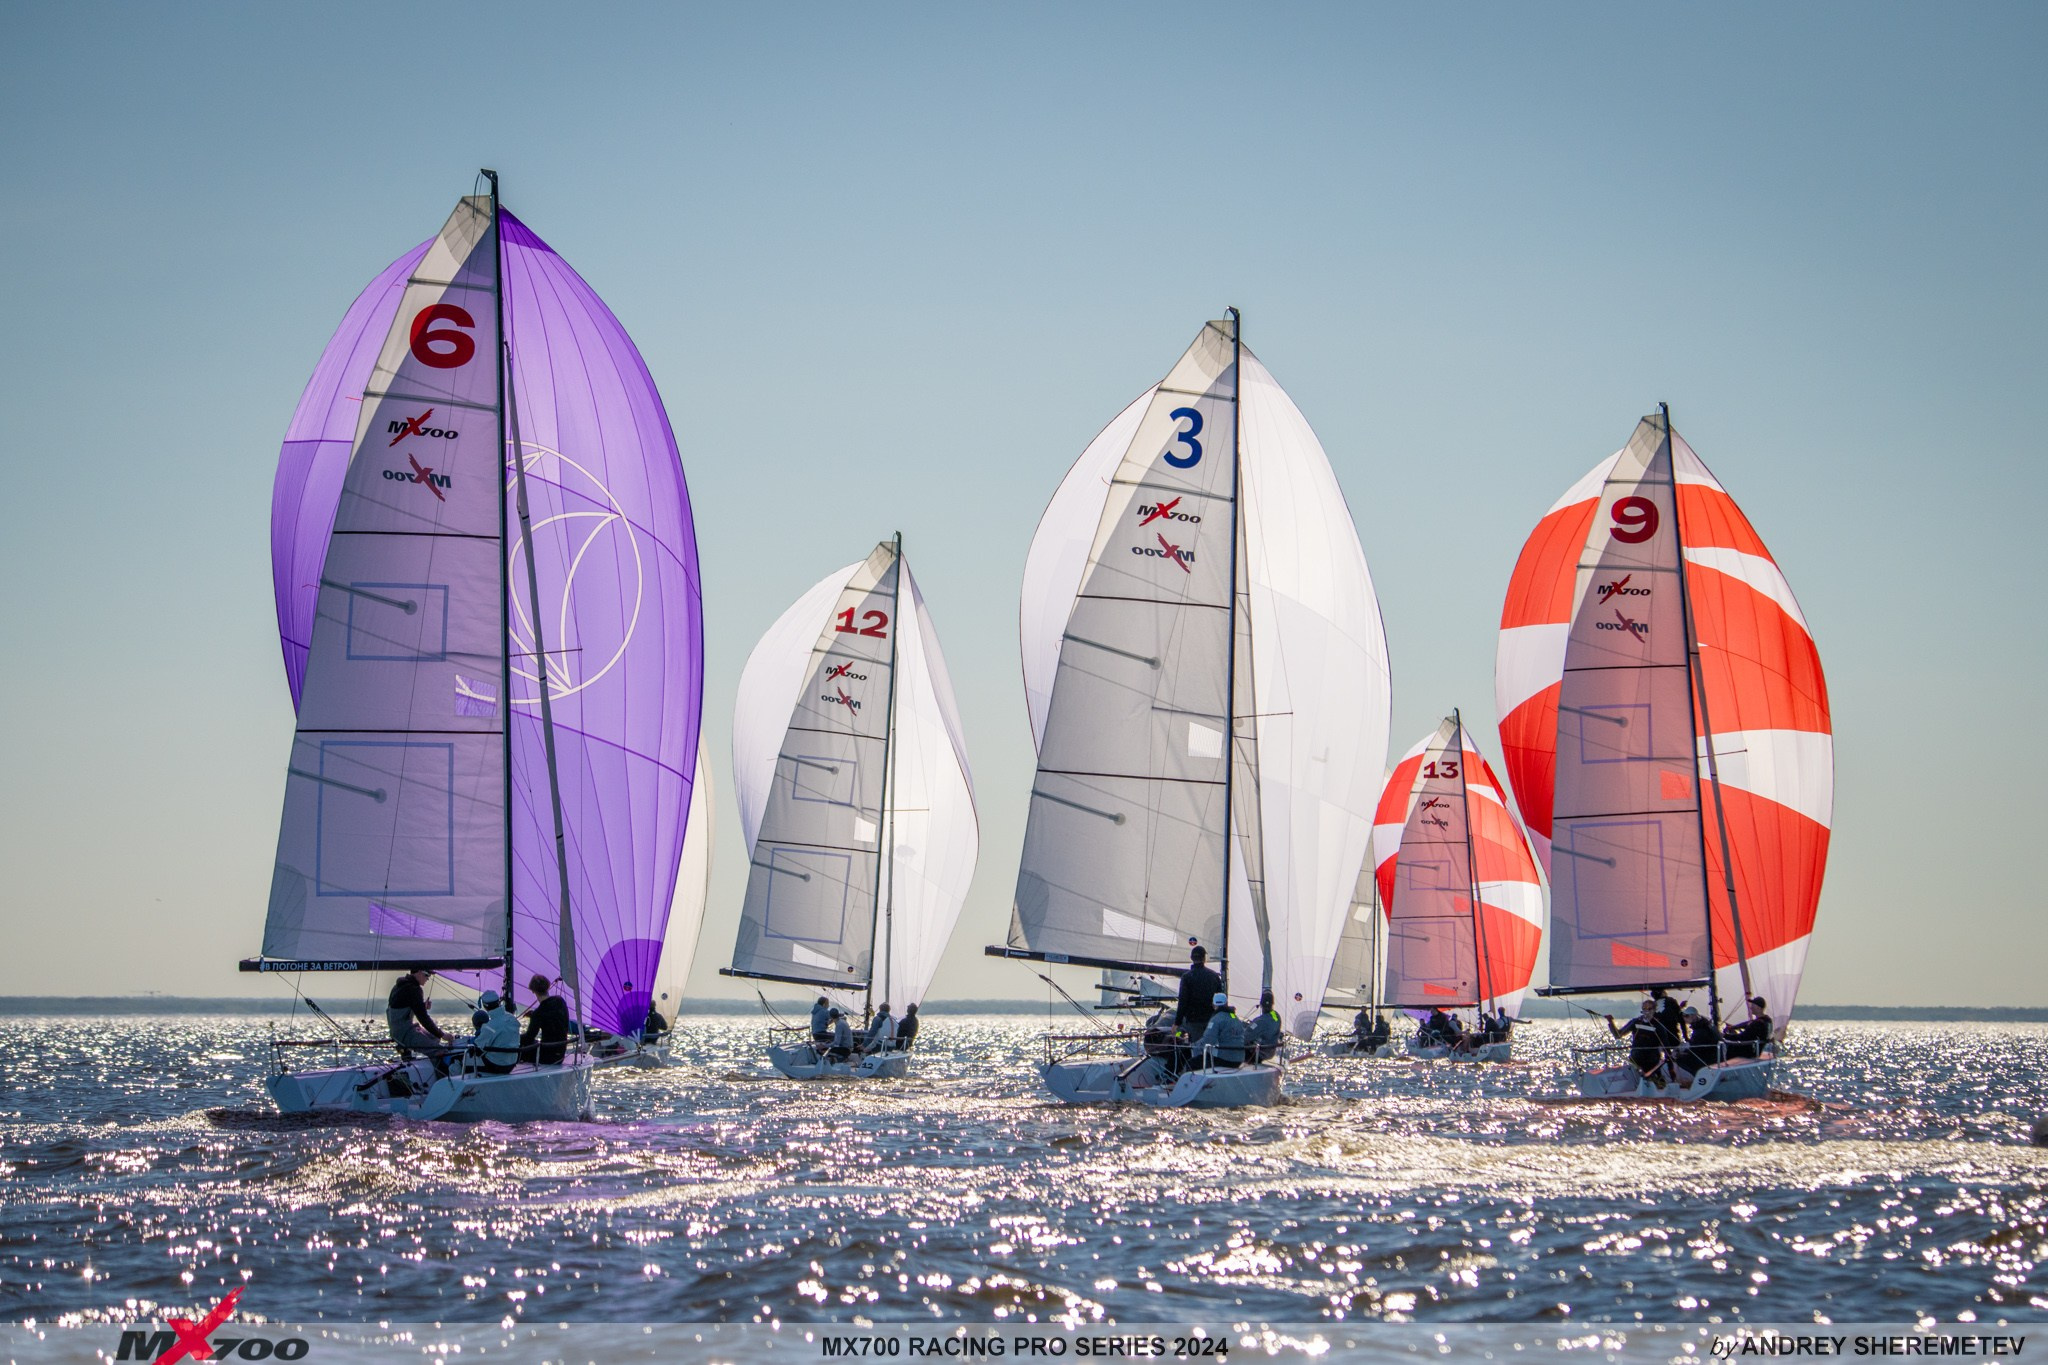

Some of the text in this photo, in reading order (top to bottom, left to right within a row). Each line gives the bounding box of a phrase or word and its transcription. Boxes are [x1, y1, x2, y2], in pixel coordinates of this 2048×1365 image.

[409, 303, 476, 369] 6
[387, 408, 459, 447] MX700
[1163, 407, 1204, 469] 3
[1136, 496, 1202, 527] MX700
[1610, 496, 1659, 544] 9
[1597, 574, 1651, 605] MX700
[835, 606, 889, 639] 12
[825, 661, 867, 682] MX700
[1423, 761, 1459, 779] 13
[272, 962, 309, 970] ПОГОНЕ
[310, 962, 322, 970] ЗА
[323, 962, 358, 970] ВЕТРОМ
[862, 1062, 874, 1070] 12
